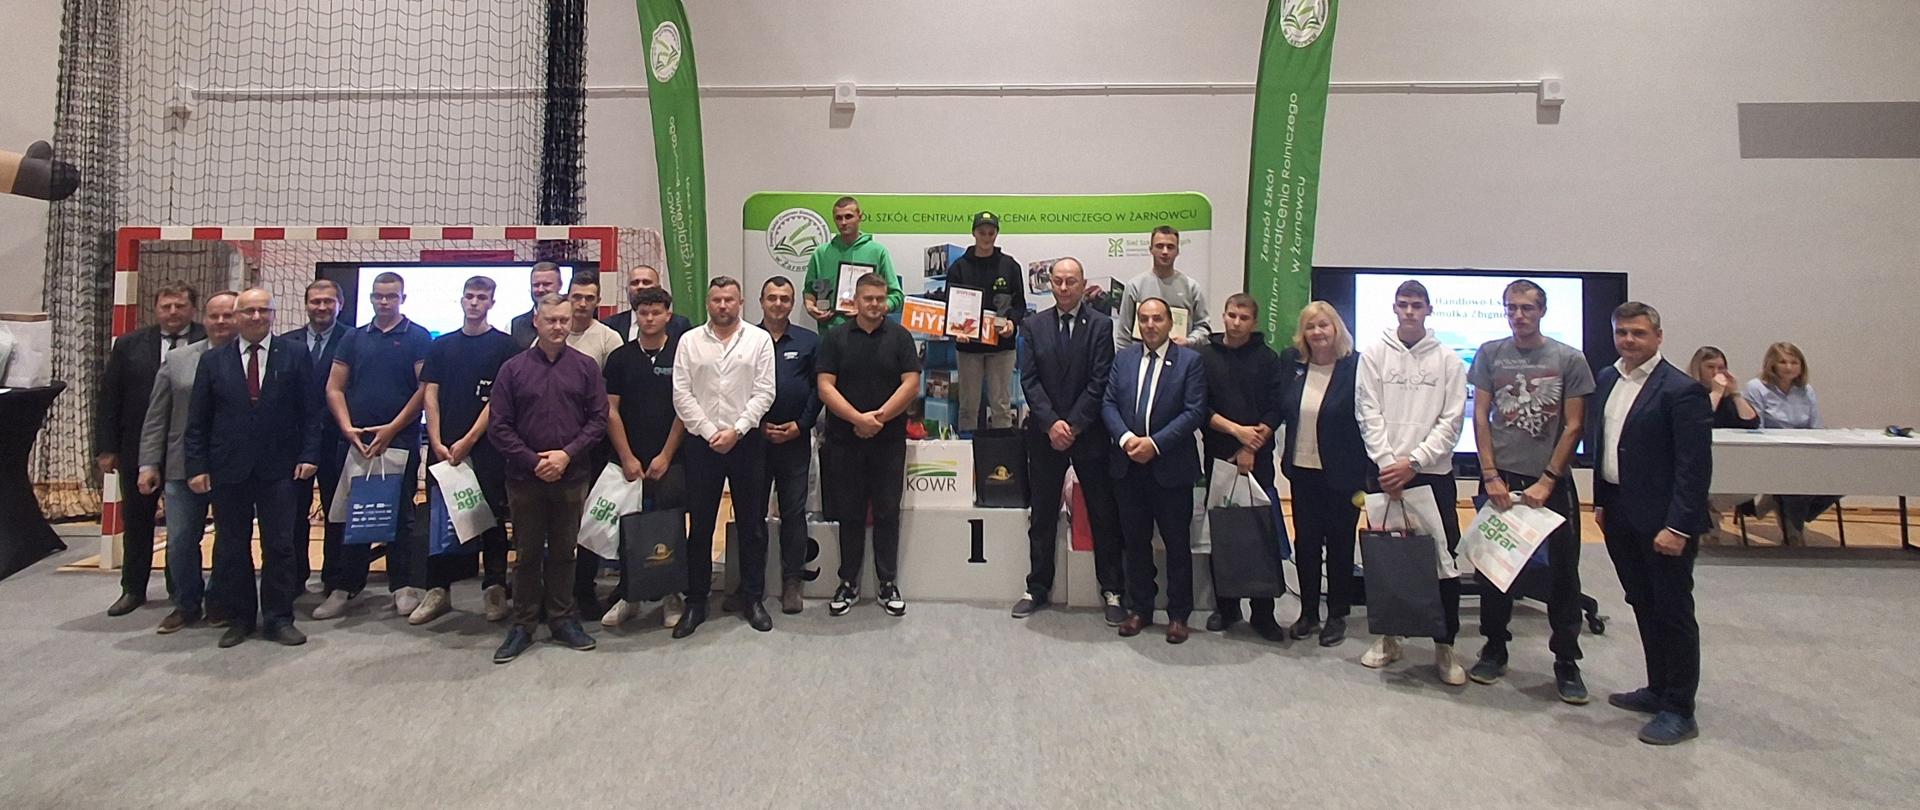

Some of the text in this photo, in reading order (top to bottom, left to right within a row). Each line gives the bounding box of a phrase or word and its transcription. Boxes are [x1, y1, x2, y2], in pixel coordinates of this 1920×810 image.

[1281, 92, 1299, 179] Rolniczego
[876, 211, 908, 223] SZKÓŁ
[912, 212, 964, 222] CENTRUM
[1040, 212, 1112, 222] ROLNICZEGO
[1115, 212, 1128, 222] W
[1129, 208, 1197, 222] ŻARNOWCU
[906, 477, 957, 492] KOWR
[453, 487, 474, 501] top
[457, 492, 484, 511] agra
[596, 496, 616, 512] top
[590, 505, 619, 525] agra
[1487, 514, 1508, 532] top
[967, 518, 988, 564] 1
[1478, 521, 1517, 551] agrar
